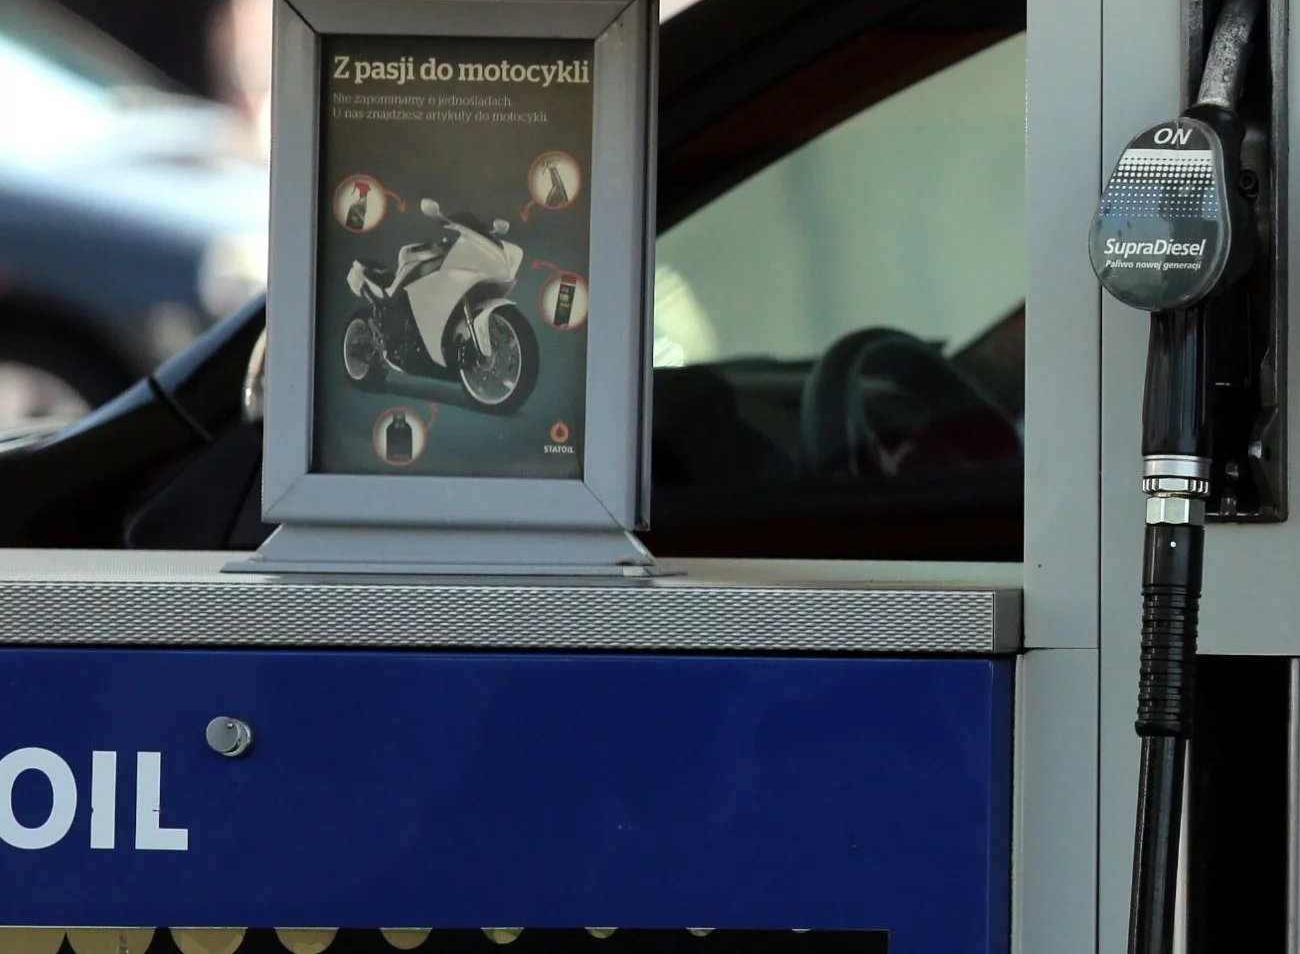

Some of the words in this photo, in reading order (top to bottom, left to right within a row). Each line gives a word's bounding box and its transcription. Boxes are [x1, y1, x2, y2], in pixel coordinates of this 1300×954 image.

[334, 56, 350, 80] Z
[354, 57, 415, 85] pasji
[419, 57, 453, 81] do
[458, 59, 590, 87] motocykli
[1153, 128, 1193, 145] ON
[1104, 238, 1207, 259] SupraDiesel
[1105, 259, 1134, 268] Paliwo
[1136, 260, 1162, 271] nowej
[1163, 261, 1202, 271] generacji
[543, 445, 574, 454] STATOIL
[0, 747, 188, 850] OIL
